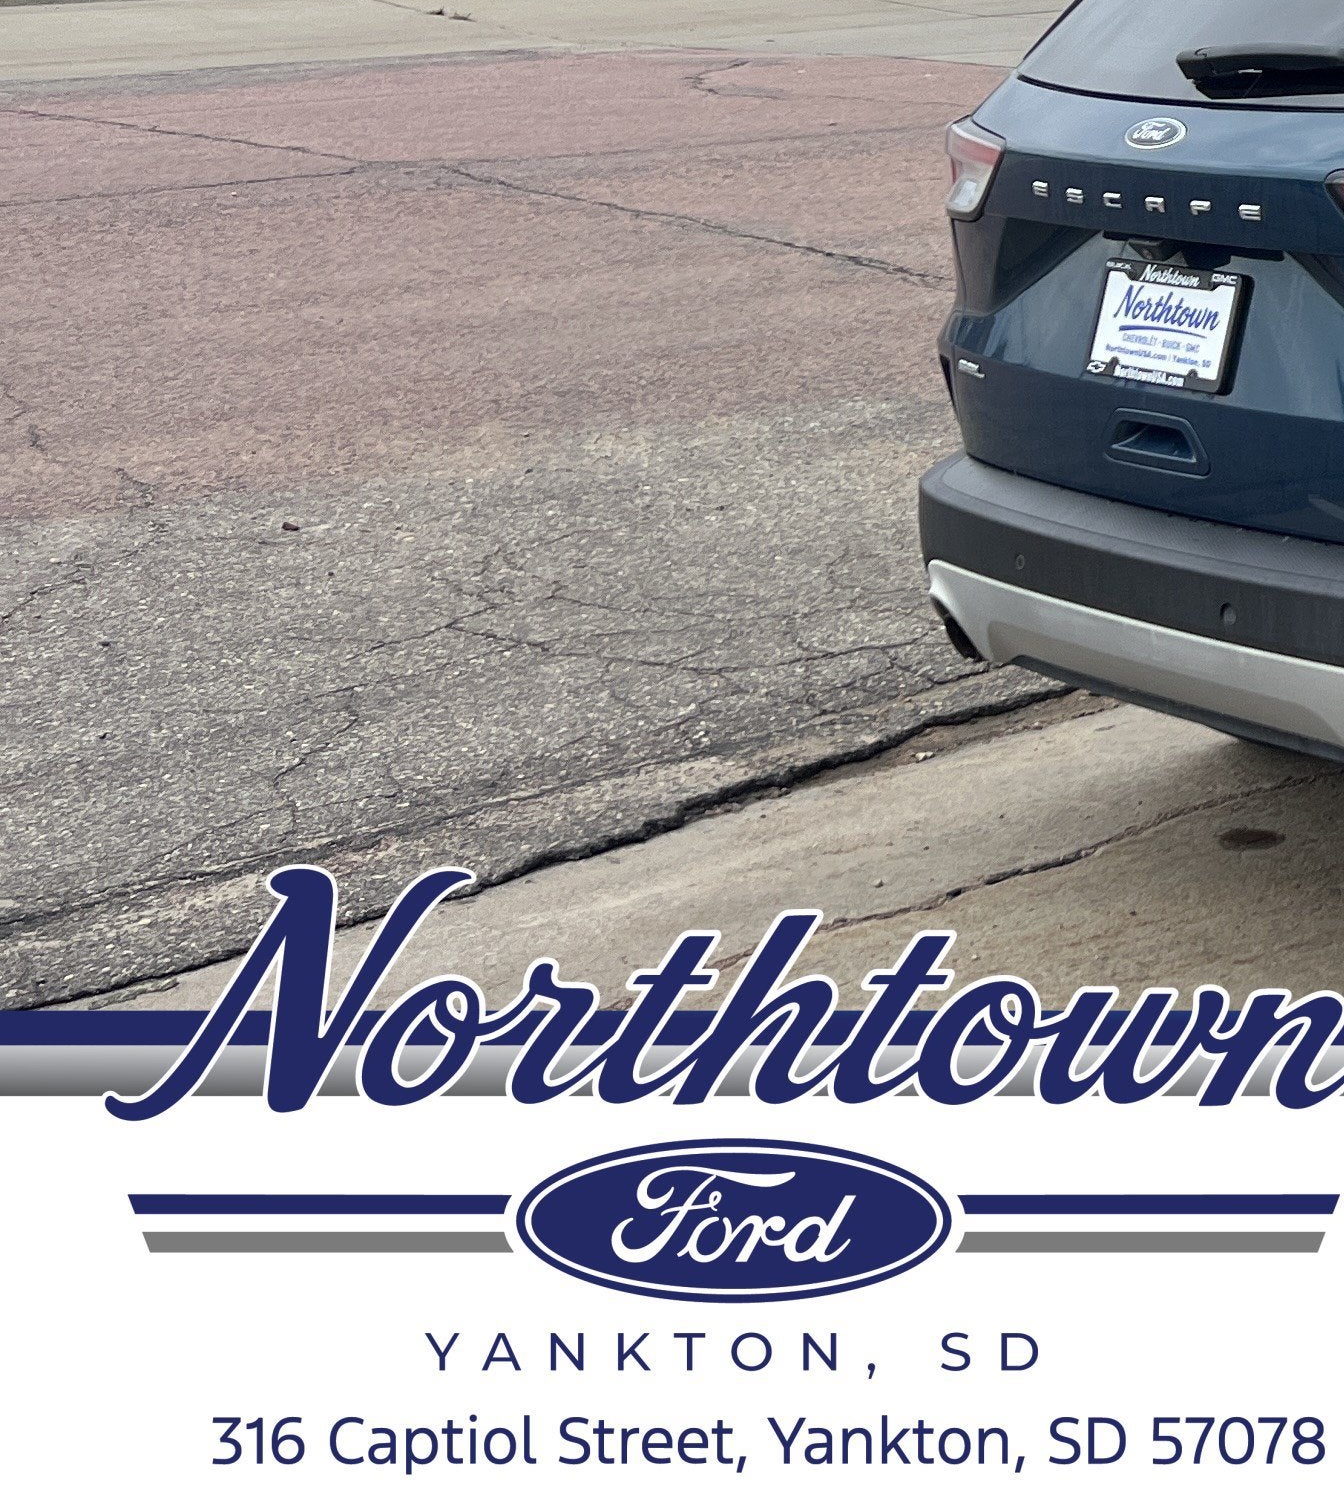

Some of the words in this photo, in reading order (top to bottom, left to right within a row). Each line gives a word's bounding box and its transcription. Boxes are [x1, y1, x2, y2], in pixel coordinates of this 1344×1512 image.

[1132, 121, 1171, 141] Ford
[1032, 180, 1262, 221] ESCAPE
[1139, 264, 1200, 287] Northtown
[1211, 273, 1238, 284] GMC
[1113, 284, 1220, 330] Northtown
[1105, 344, 1167, 361] NorthtownUSA.com
[1113, 364, 1185, 387] NorthtownUSA.com
